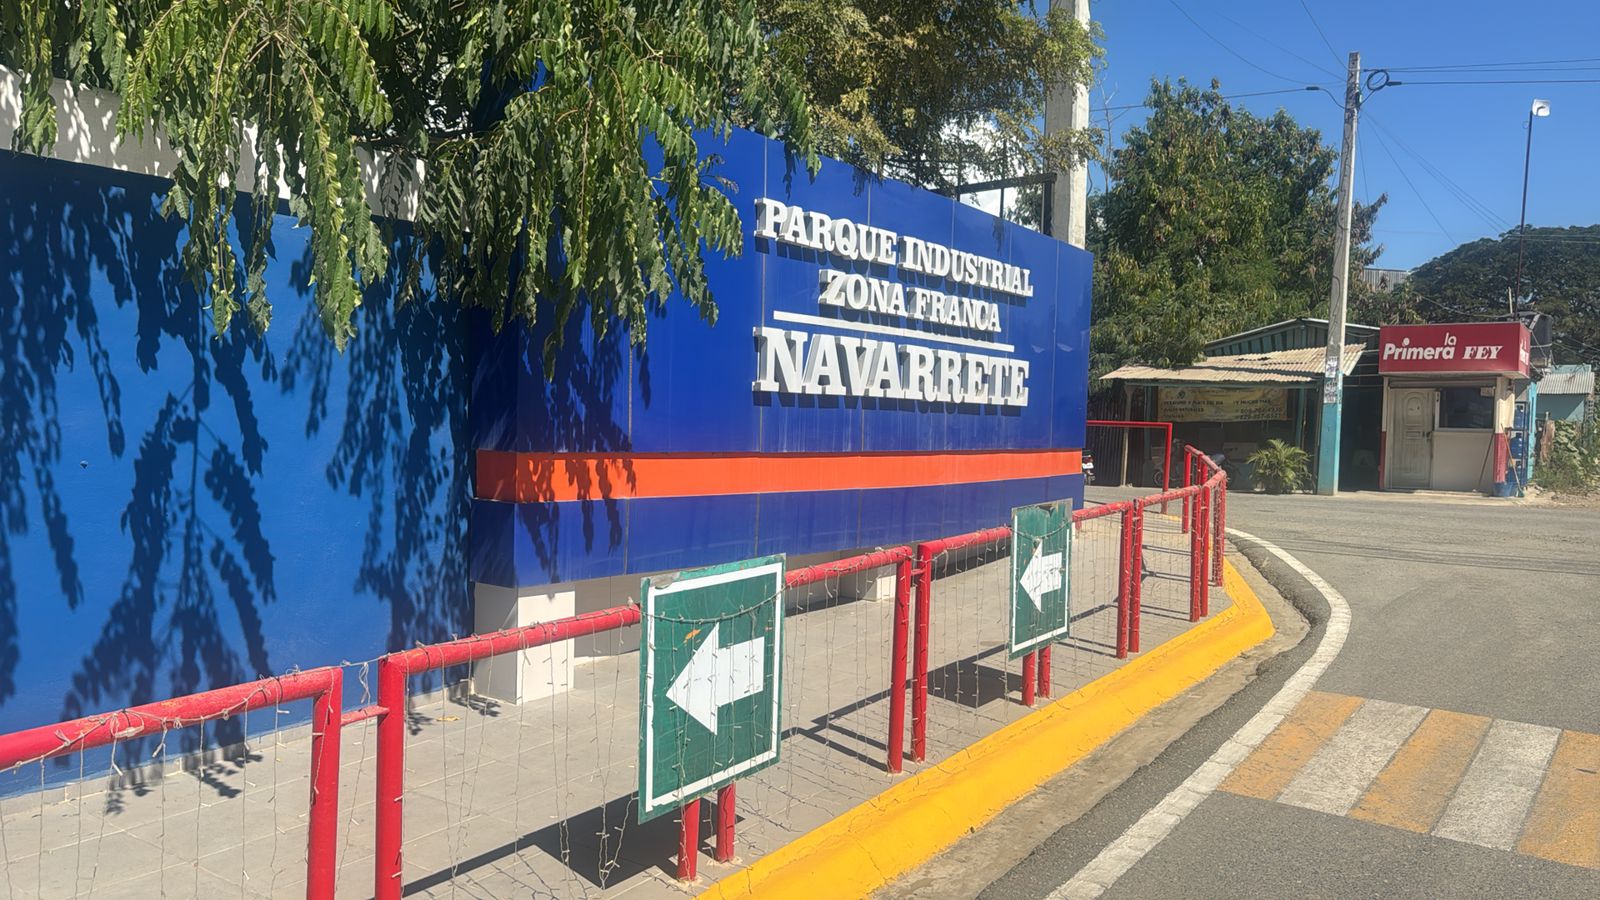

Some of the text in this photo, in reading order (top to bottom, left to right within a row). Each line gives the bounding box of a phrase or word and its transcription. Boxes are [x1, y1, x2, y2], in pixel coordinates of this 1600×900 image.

[754, 198, 1034, 297] PARQUE INDUSTRIAL
[818, 269, 1002, 333] ZONA FRANCA
[752, 327, 1030, 407] NAVARRETE
[1383, 338, 1455, 360] Primera
[1462, 345, 1503, 360] FEY
[1444, 332, 1457, 346] la
